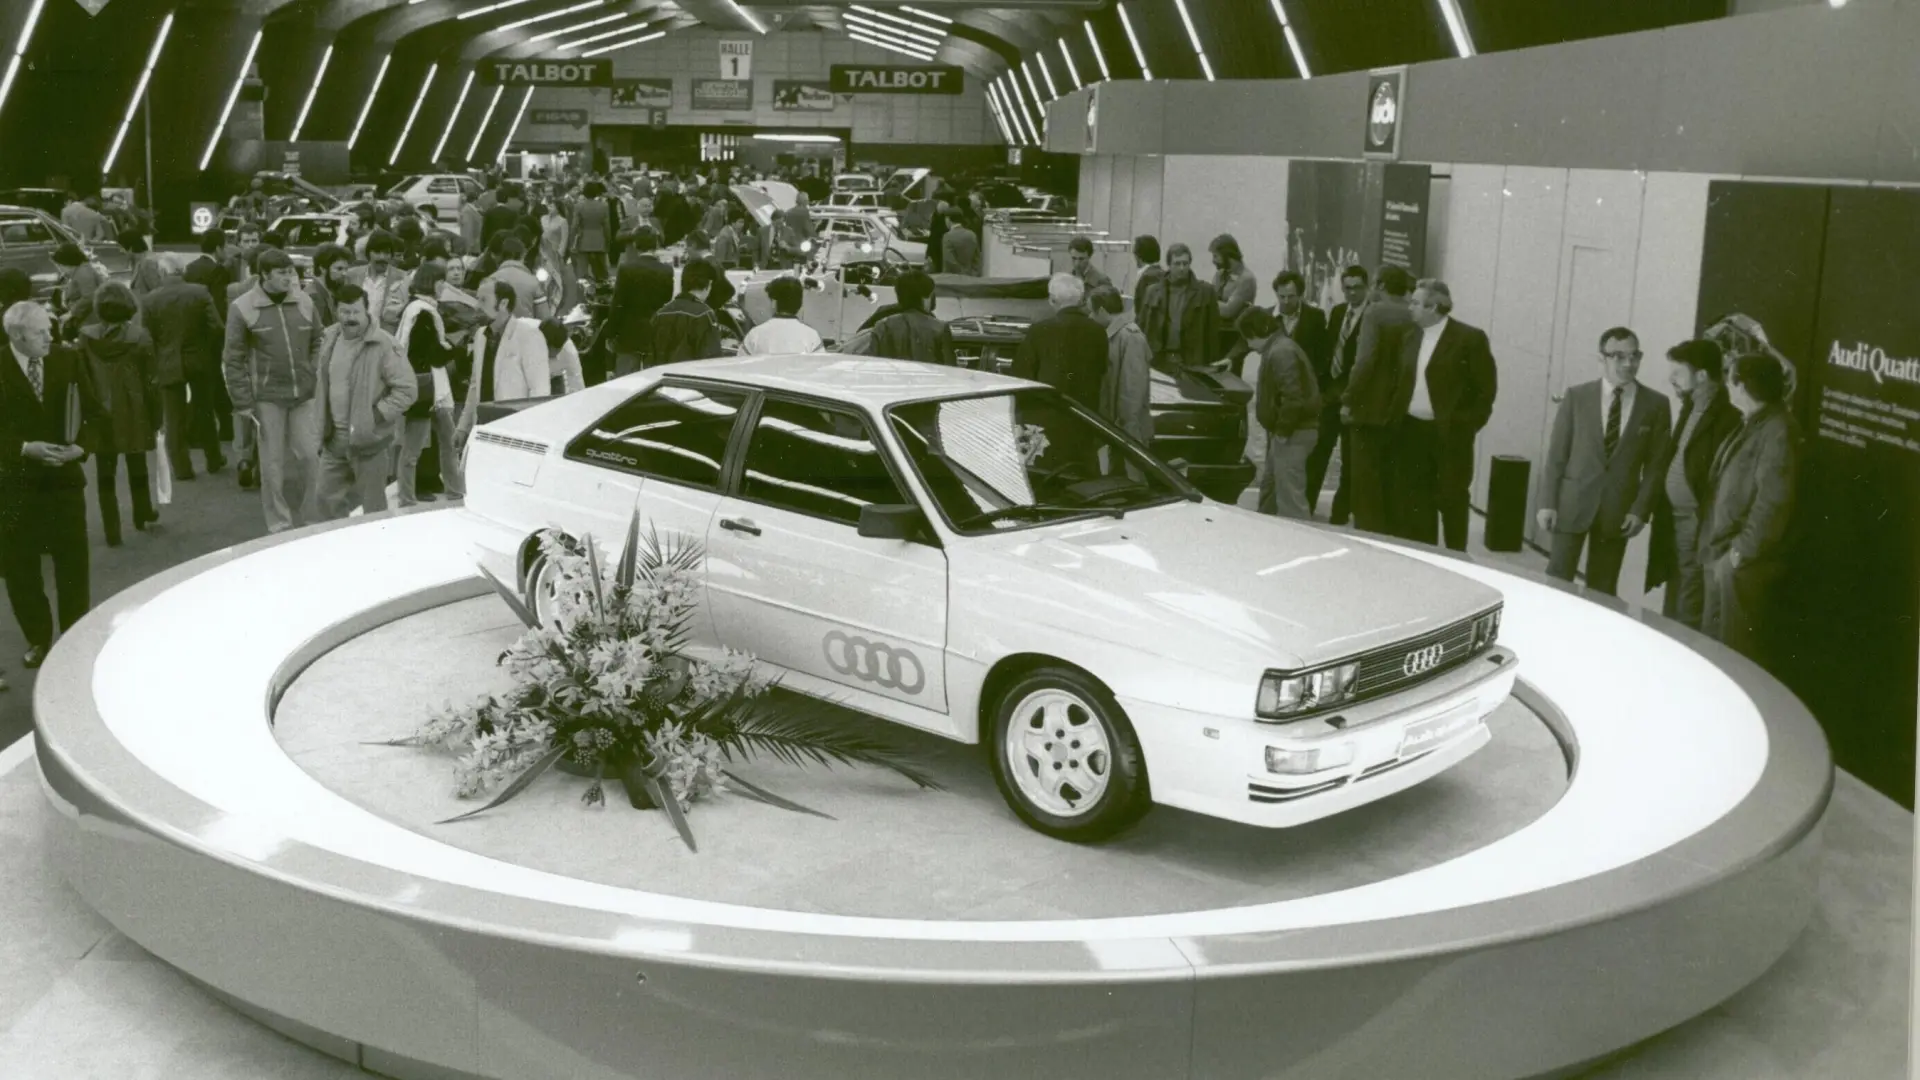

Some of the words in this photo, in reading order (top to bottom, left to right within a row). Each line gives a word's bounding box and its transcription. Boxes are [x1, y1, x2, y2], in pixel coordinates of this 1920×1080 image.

[495, 64, 597, 82] TALBOT
[731, 57, 738, 76] 1
[844, 70, 947, 88] TALBOT
[586, 448, 638, 466] quattro
